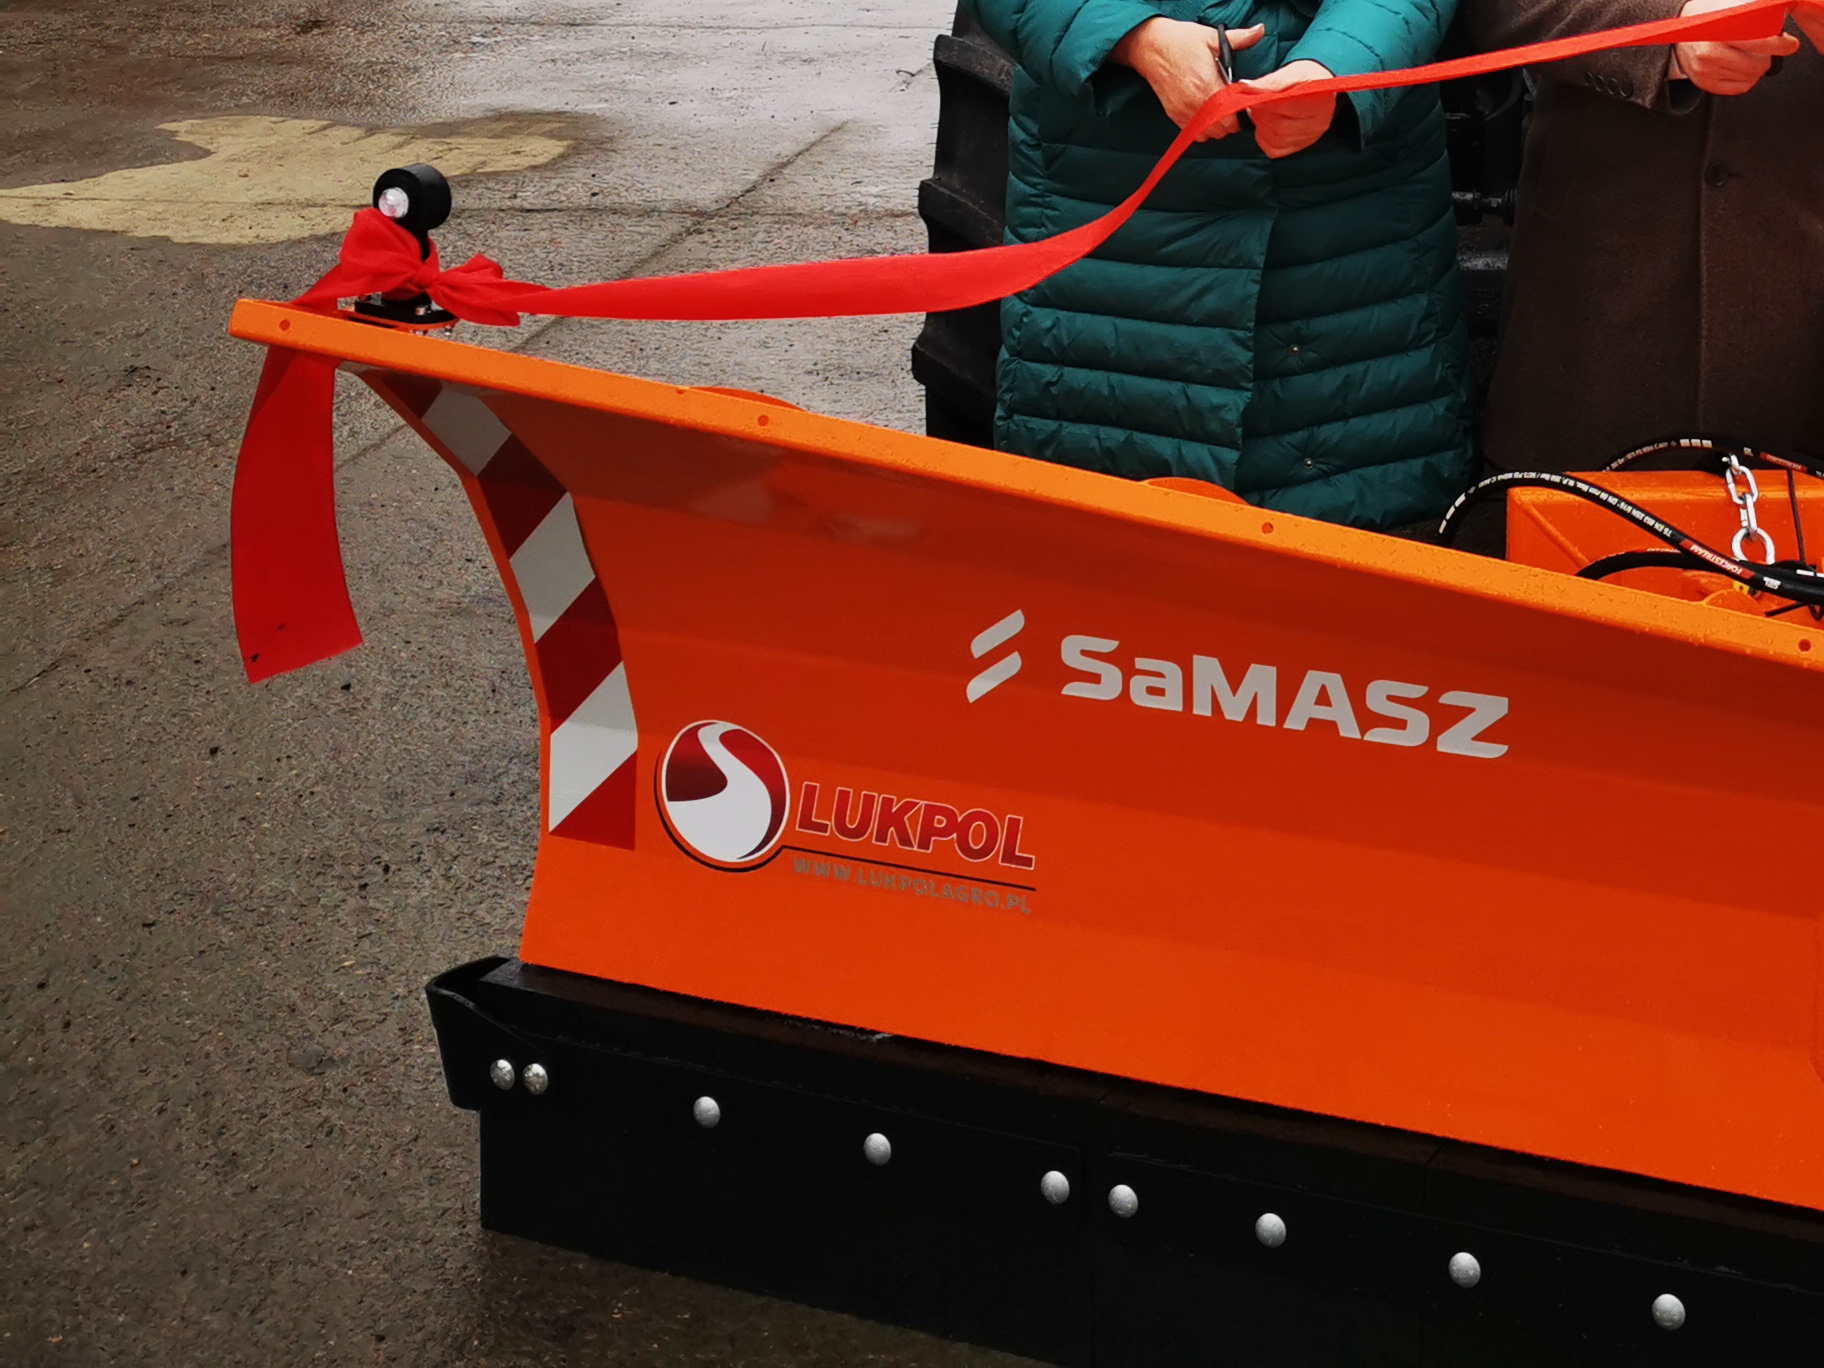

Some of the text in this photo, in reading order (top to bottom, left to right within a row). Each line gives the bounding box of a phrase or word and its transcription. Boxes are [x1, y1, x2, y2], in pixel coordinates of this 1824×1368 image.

[1060, 634, 1510, 759] SaMASZ
[796, 781, 1036, 871] LUKPOL
[793, 856, 1032, 915] WWW.LUKPOLAGRO.PL
